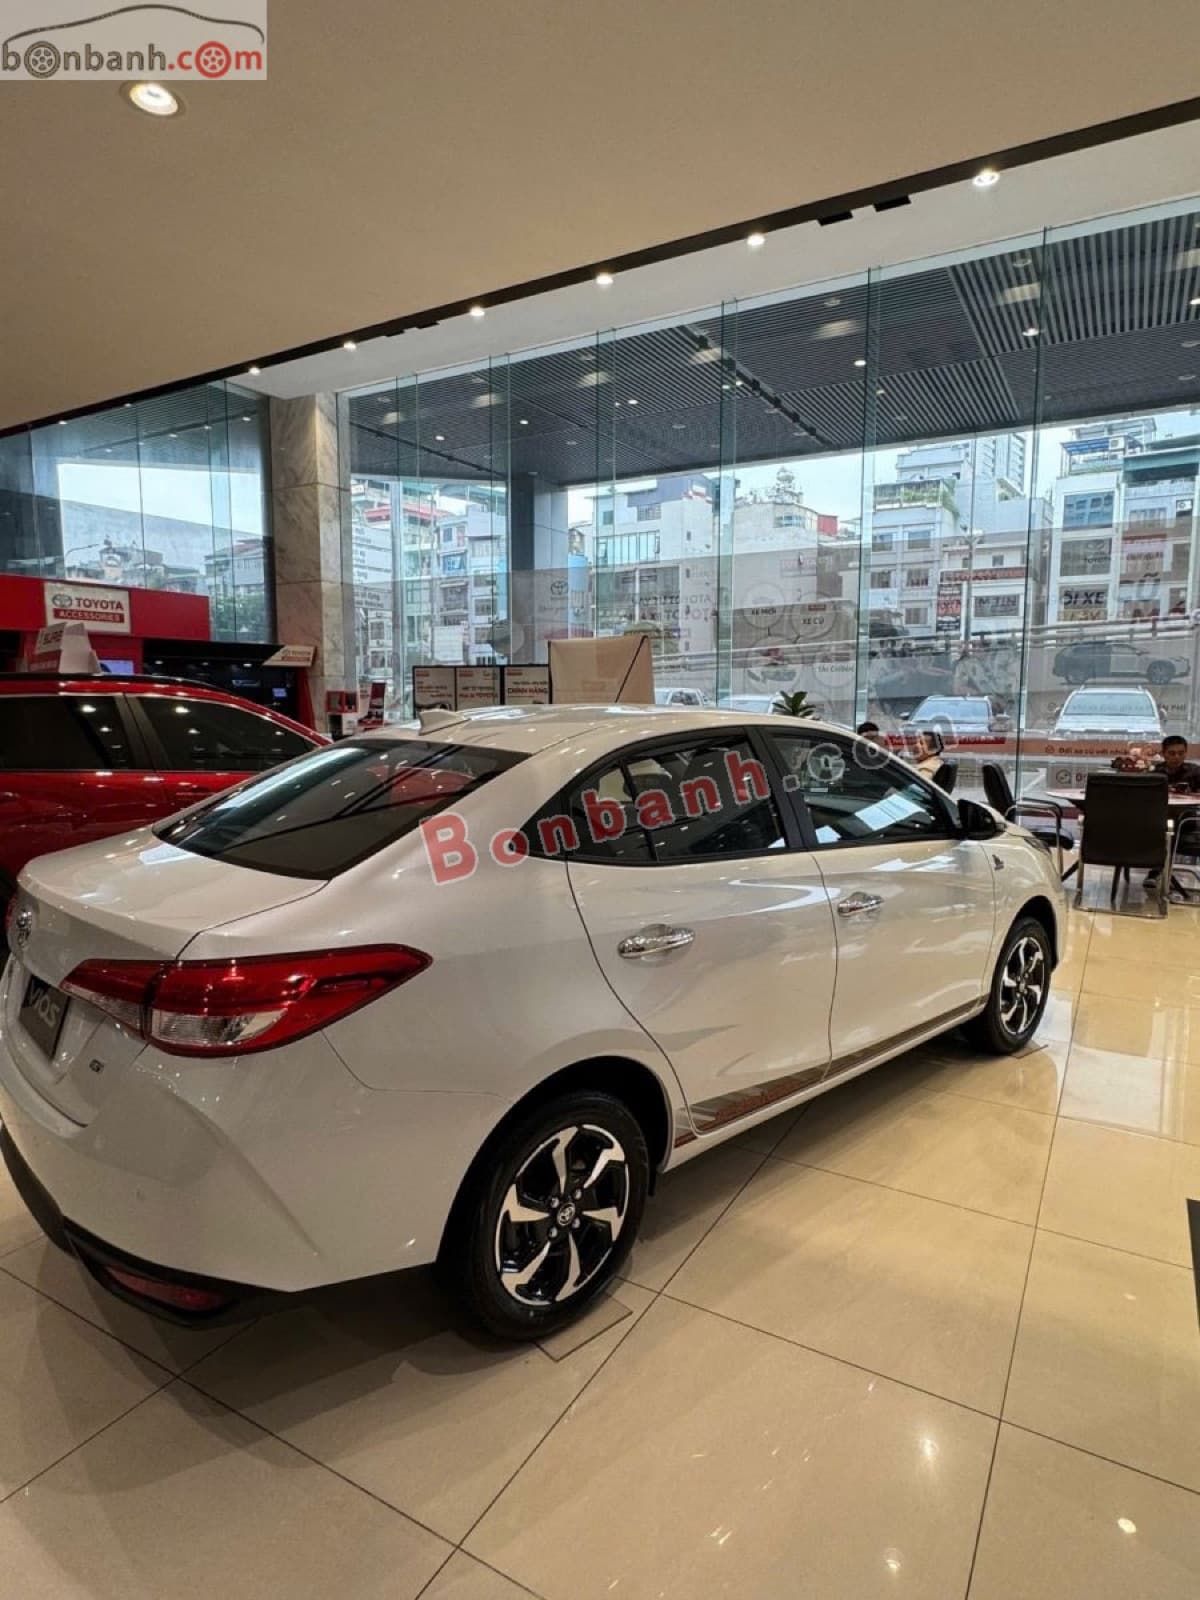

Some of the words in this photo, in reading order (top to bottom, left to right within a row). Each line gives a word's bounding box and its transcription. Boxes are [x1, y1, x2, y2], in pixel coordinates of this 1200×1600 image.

[76, 597, 124, 611] TOYOTA
[1083, 591, 1105, 605] XE
[58, 610, 121, 621] ACCESSORIES
[29, 982, 61, 1028] VIOS
